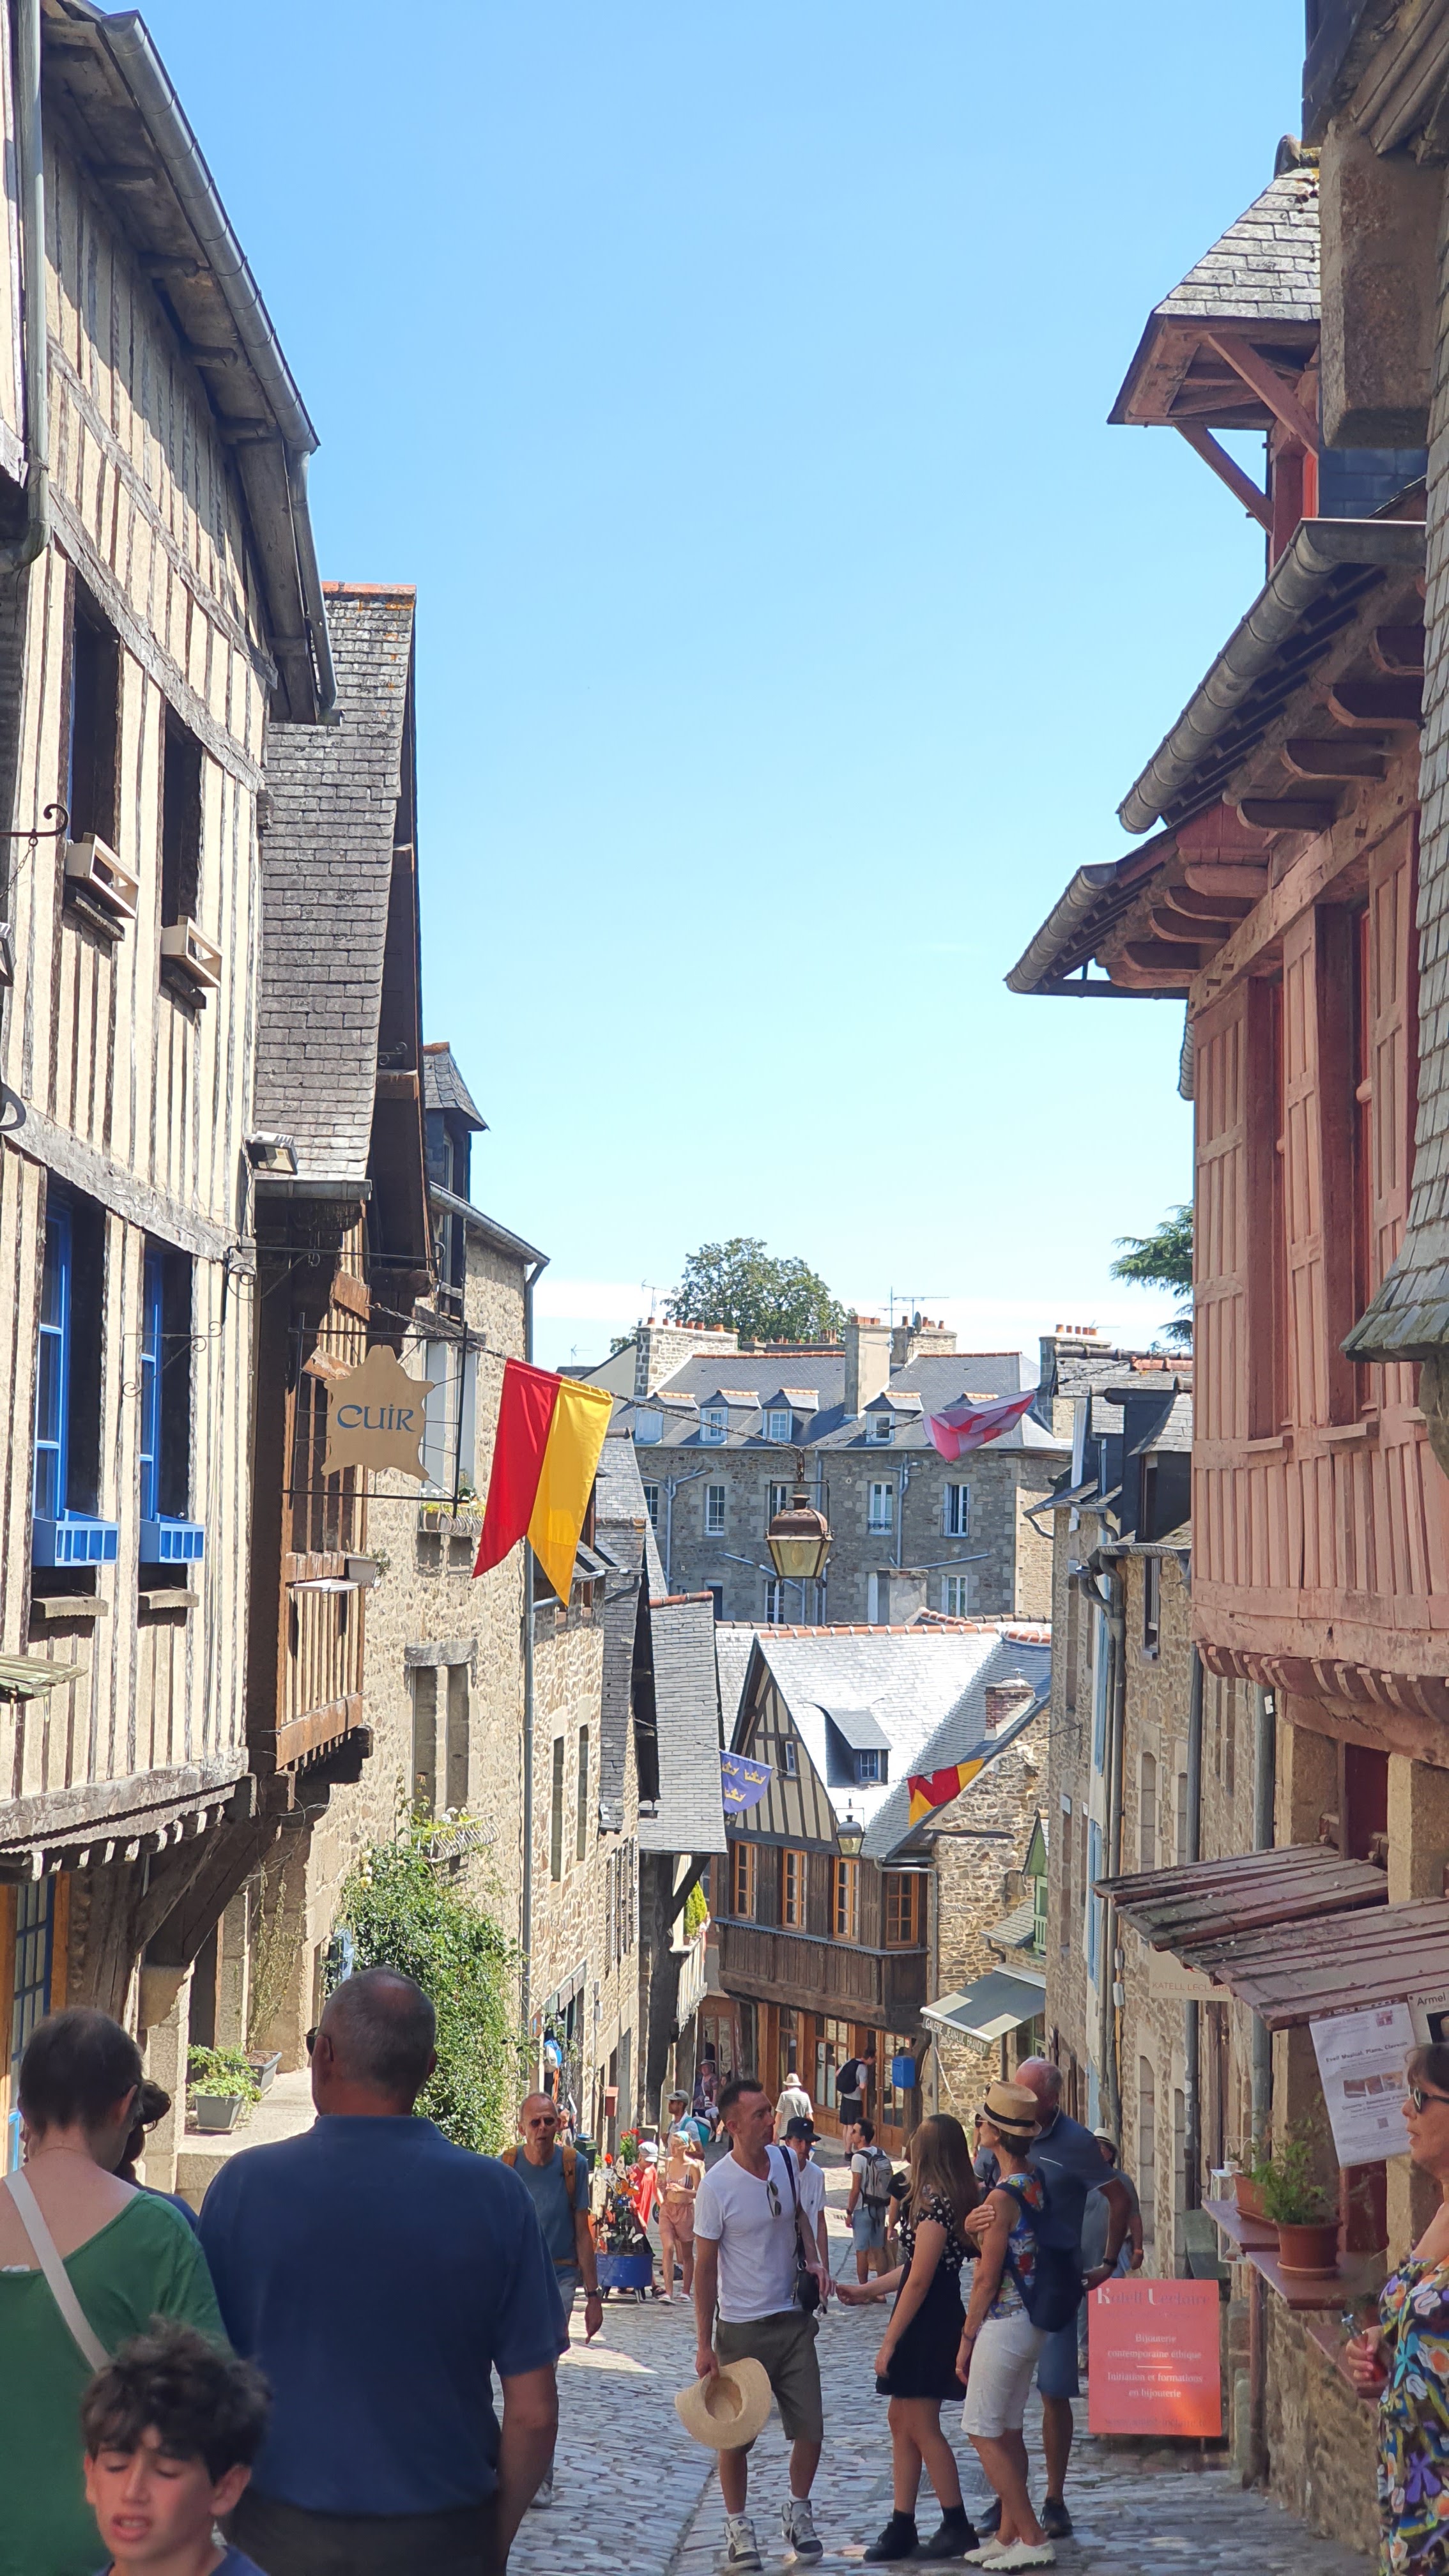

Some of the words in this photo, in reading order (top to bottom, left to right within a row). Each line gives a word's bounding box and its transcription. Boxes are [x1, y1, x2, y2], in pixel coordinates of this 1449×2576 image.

[337, 1404, 416, 1432] CUIR
[1153, 1982, 1184, 1991] KATELL
[1417, 1991, 1446, 2006] Armel
[925, 2018, 944, 2035] GALERIE
[1135, 2334, 1177, 2344] Bijouterie
[1108, 2350, 1169, 2360] contemporaine
[1108, 2372, 1145, 2381] Initiation
[1158, 2373, 1202, 2382] formations
[1141, 2388, 1181, 2400] bijouterie
